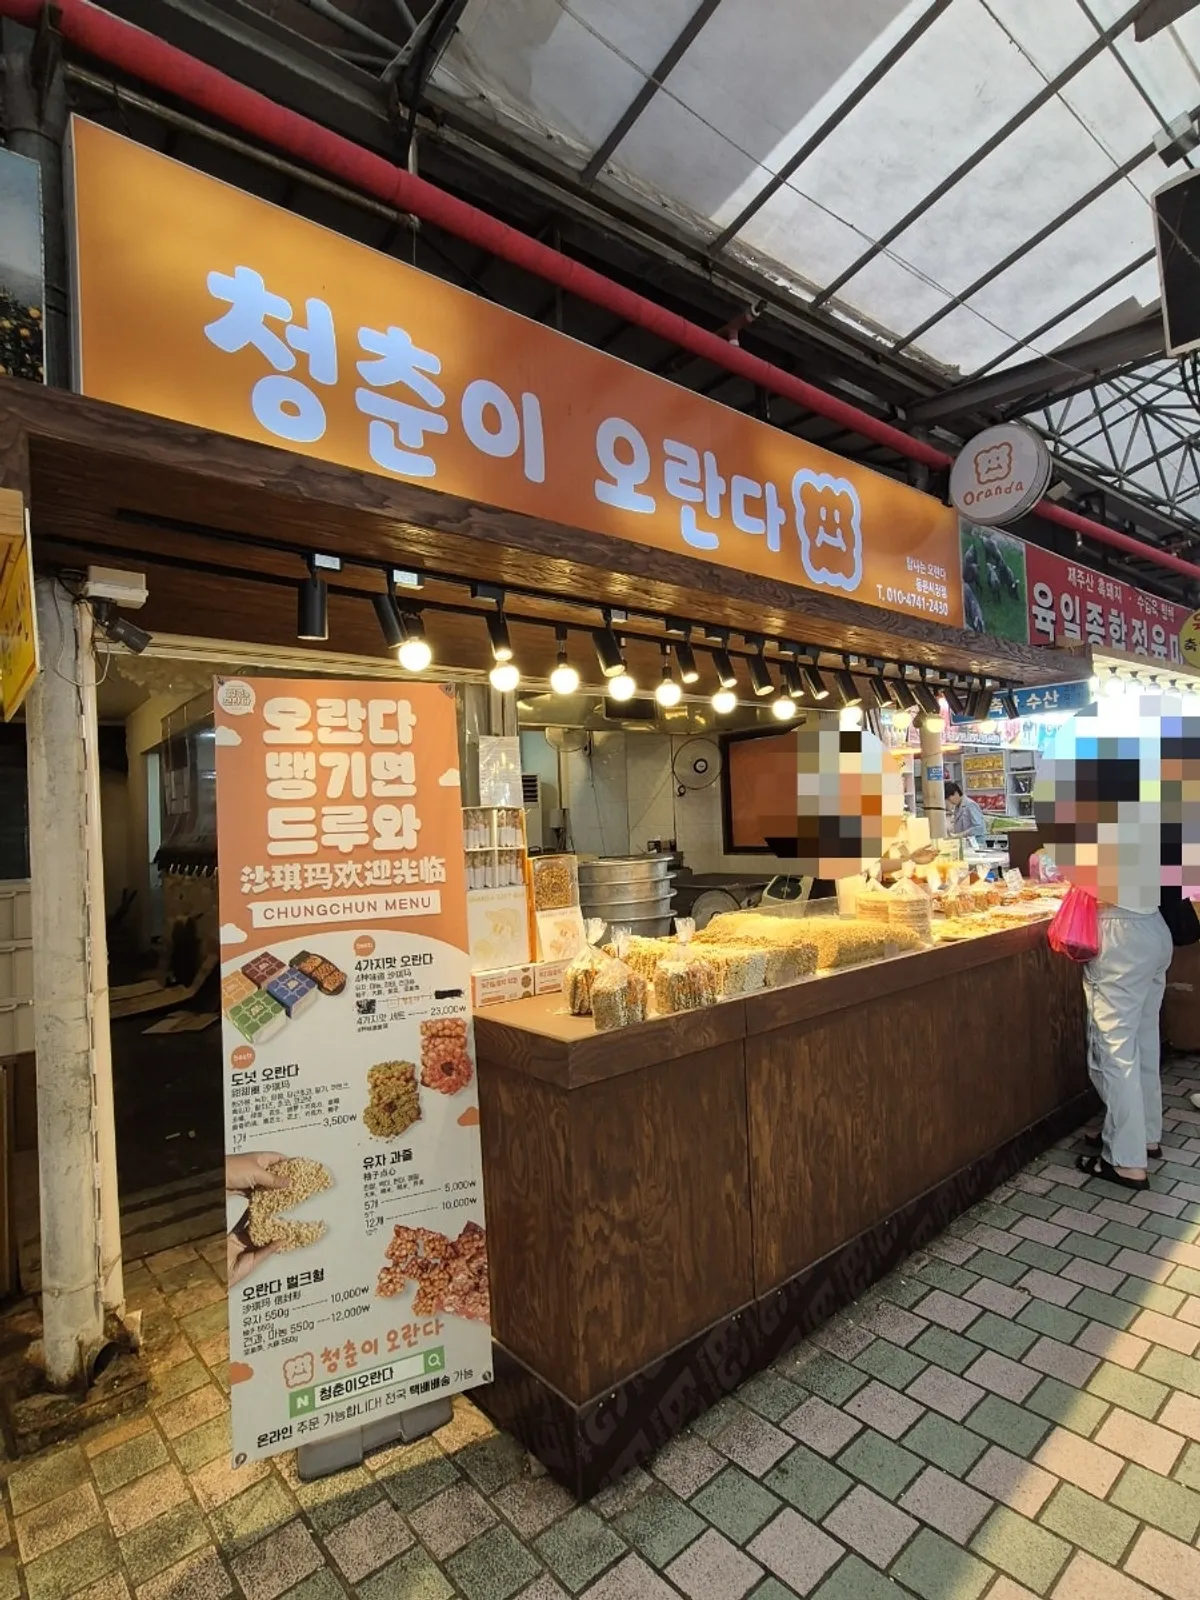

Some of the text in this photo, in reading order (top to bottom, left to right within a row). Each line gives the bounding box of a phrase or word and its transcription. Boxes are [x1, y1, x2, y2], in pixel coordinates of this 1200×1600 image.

[204, 265, 786, 553] 청춘이 오란다
[963, 481, 1024, 506] Oranda
[876, 583, 886, 601] T.
[1067, 566, 1094, 592] 제주산
[1097, 577, 1122, 604] 흑돼지
[1026, 690, 1059, 710] 수산
[262, 697, 417, 745] 오란다
[267, 804, 421, 856] 드루와
[240, 856, 447, 894] 沙琪玛欢迎光临
[263, 896, 432, 921] CHUNGCHUN MENU
[355, 953, 434, 972] 4가지맛 오란다
[231, 1063, 300, 1087] 도넛 오란다
[363, 1154, 386, 1170] 유자
[364, 1199, 379, 1211] 5개
[242, 1267, 325, 1303] 오란다 벌크형
[265, 1307, 290, 1322] 550g
[290, 1319, 315, 1334] 550g
[320, 1318, 445, 1373] 청춘이 오란다
[319, 1366, 395, 1401] 청춘이오란다
[256, 1424, 293, 1448] 온라인
[297, 1416, 320, 1434] 주문
[453, 1367, 474, 1383] 가능
[296, 1394, 309, 1409] N
